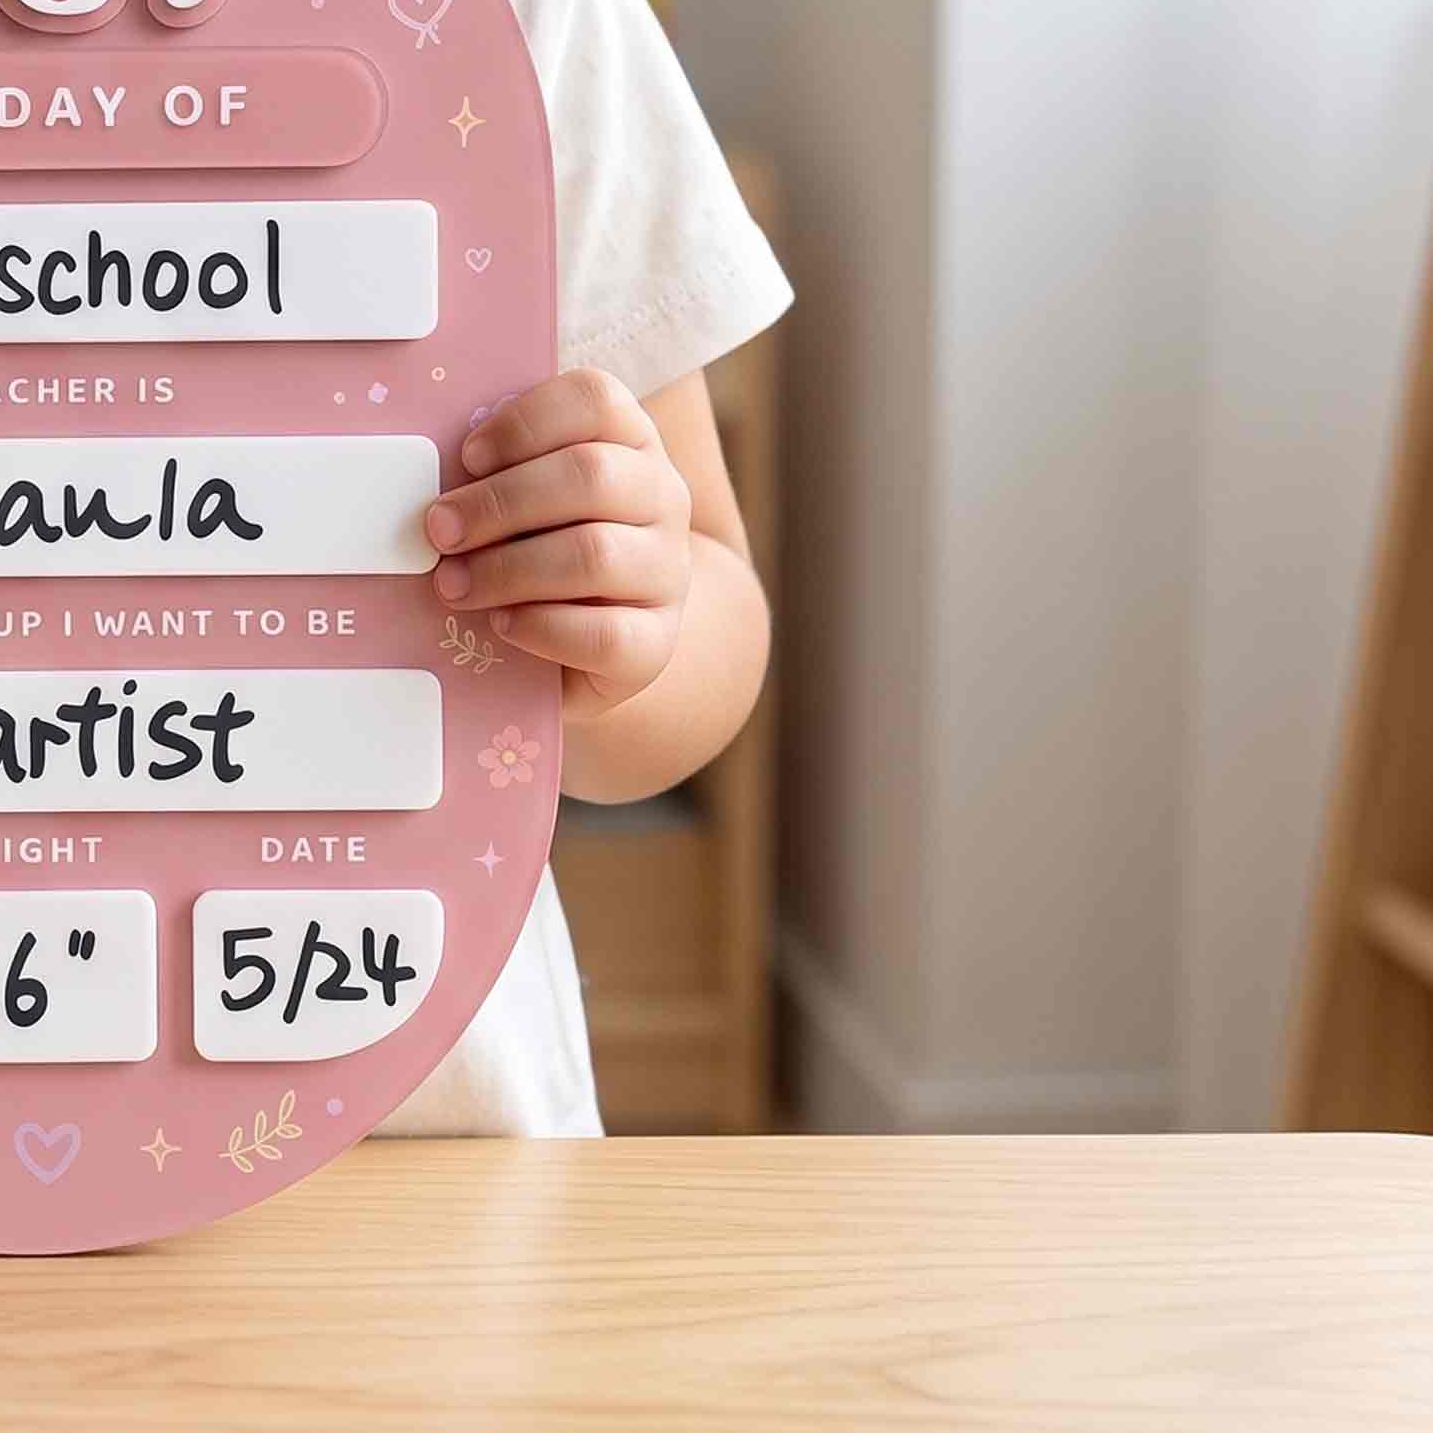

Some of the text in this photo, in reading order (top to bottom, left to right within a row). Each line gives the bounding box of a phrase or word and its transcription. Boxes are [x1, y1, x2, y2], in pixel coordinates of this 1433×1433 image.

[163, 84, 248, 127] OF
[138, 376, 175, 404] IS
[63, 610, 72, 638] I
[93, 609, 214, 637] WANT
[232, 609, 286, 636] TO
[307, 609, 356, 636] BE
[260, 835, 367, 864] DATE
[220, 920, 417, 1025] 5/24
